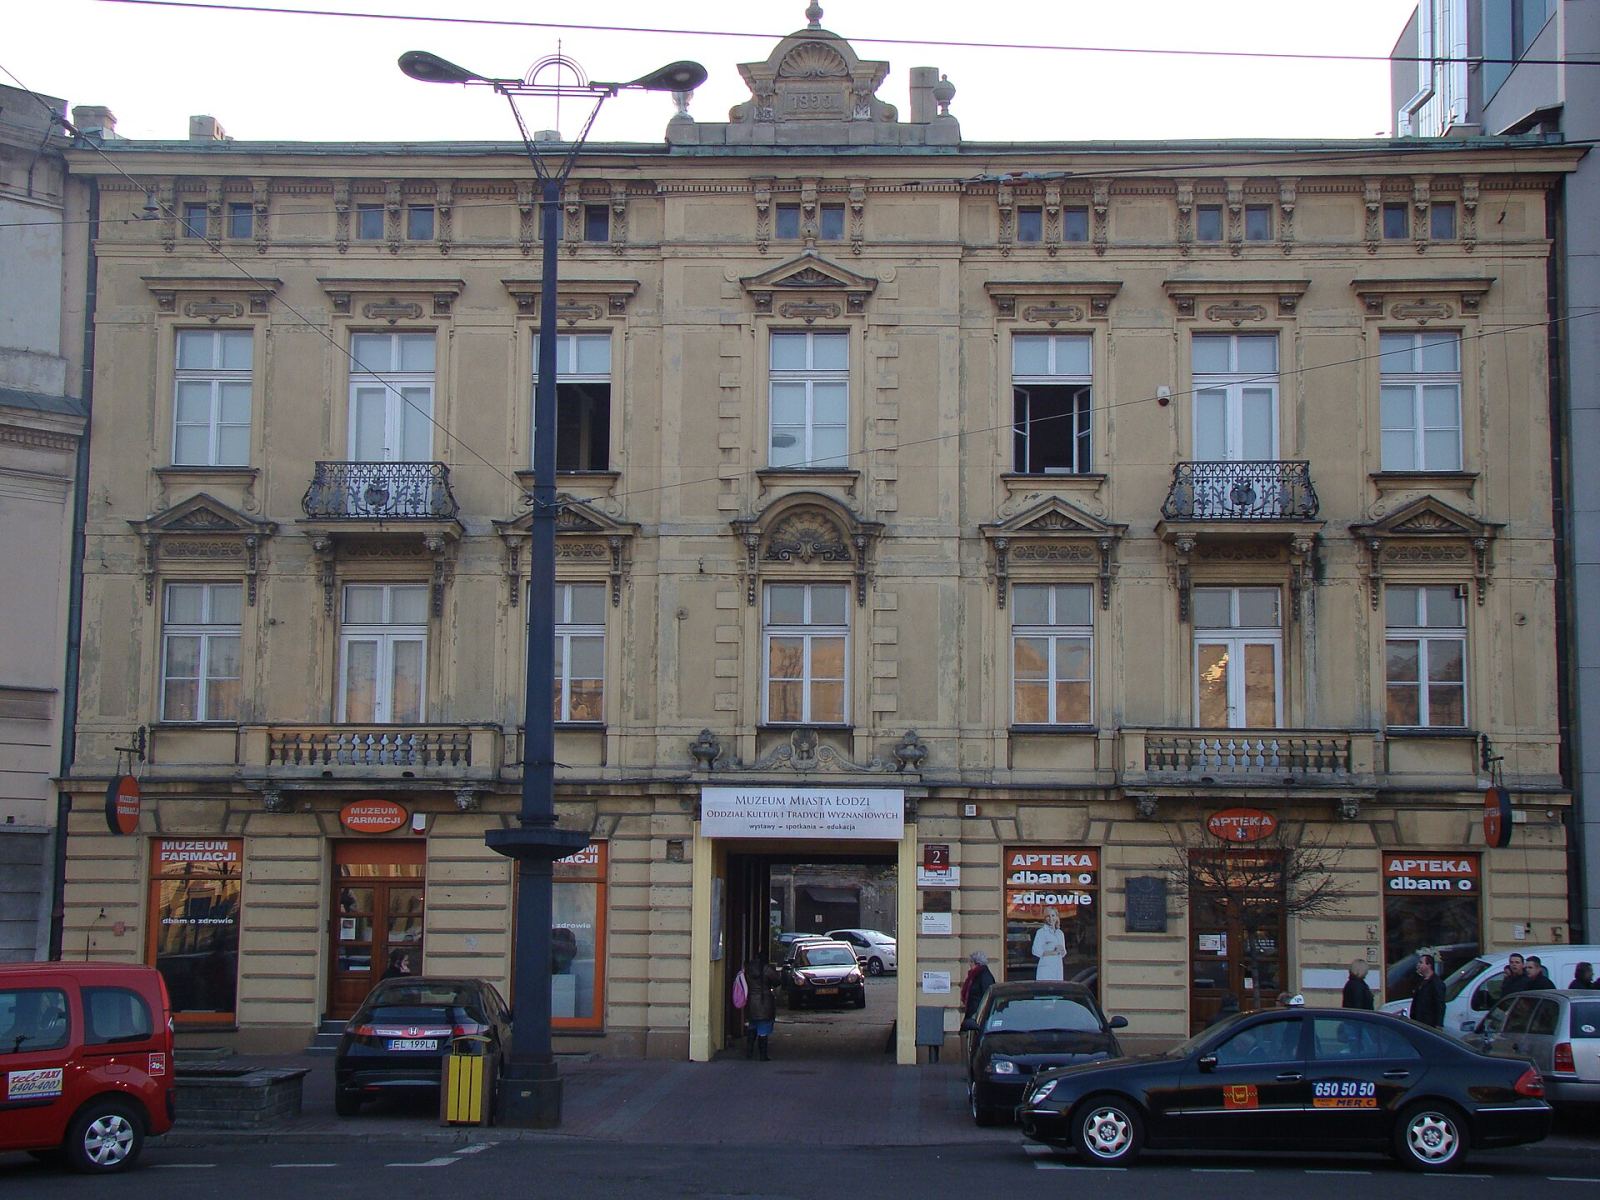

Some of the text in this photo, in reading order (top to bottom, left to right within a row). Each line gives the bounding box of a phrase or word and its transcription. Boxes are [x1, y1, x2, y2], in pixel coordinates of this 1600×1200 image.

[735, 795, 870, 806] MUZEUM MIASTA ŁODZI
[350, 807, 398, 815] MUZEUM
[706, 810, 745, 818] ODDZIAŁ
[746, 810, 779, 818] KULTUR
[787, 811, 825, 819] TRADYCJI
[827, 811, 898, 819] WYZNANIOWYCH
[347, 816, 401, 824] FARMACJI
[1209, 816, 1272, 827] APTEKA
[749, 823, 776, 831] wystawy
[785, 823, 817, 831] spotkania
[826, 823, 856, 831] edukacja
[161, 841, 229, 851] MUZEUM
[161, 852, 237, 861] FARMACJI
[932, 850, 941, 864] 2
[1012, 854, 1092, 866] APTEKA
[1389, 859, 1472, 872] APTEKA
[1012, 871, 1092, 884] dbam o
[1390, 877, 1472, 890] dbam o
[1013, 891, 1092, 905] zdrowie
[1315, 1082, 1375, 1096] 650 50 50
